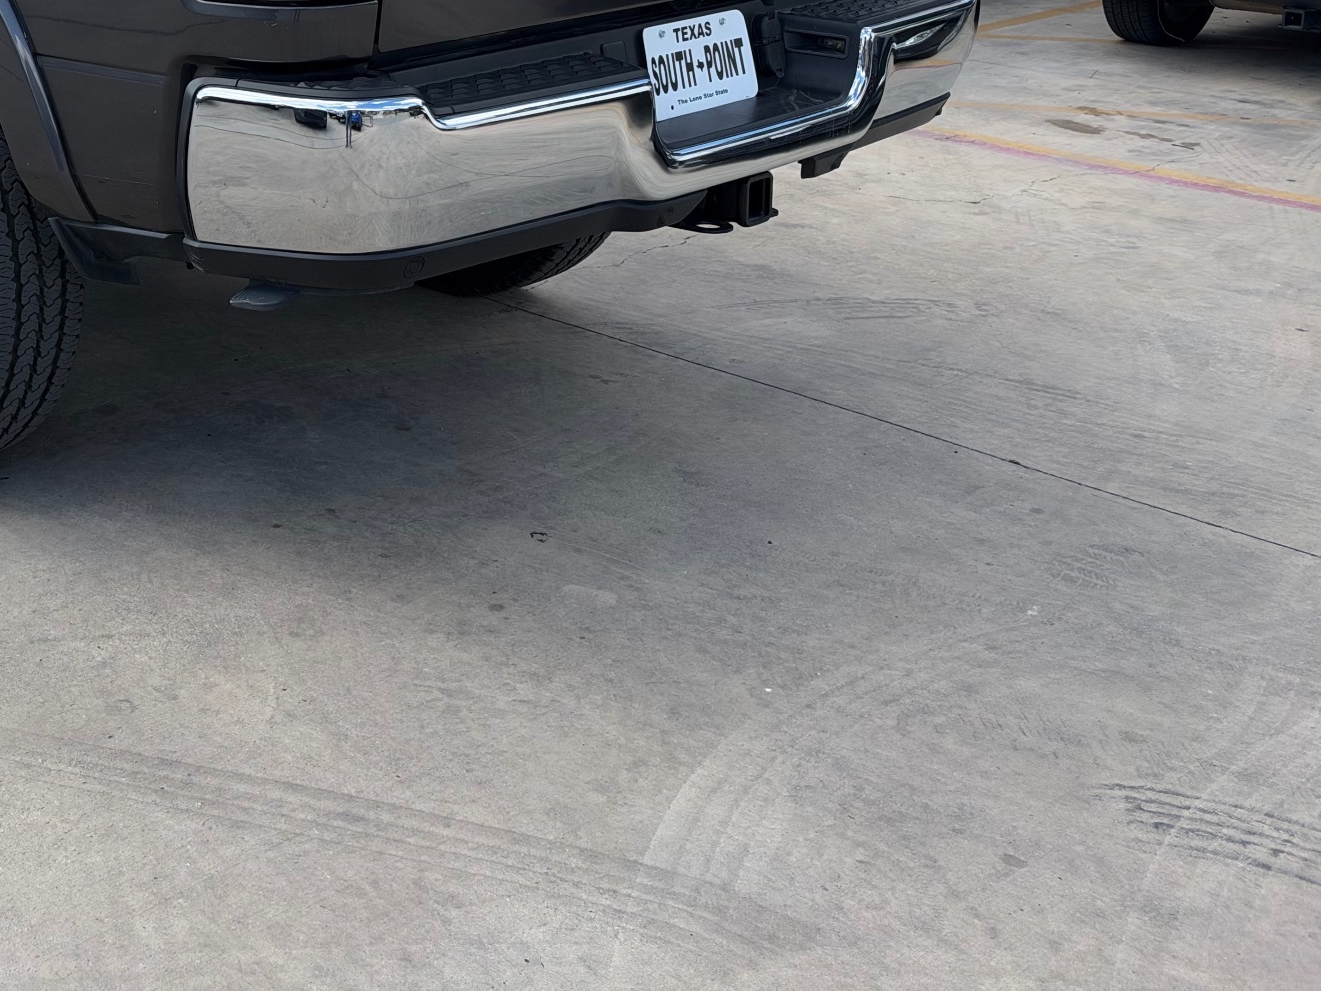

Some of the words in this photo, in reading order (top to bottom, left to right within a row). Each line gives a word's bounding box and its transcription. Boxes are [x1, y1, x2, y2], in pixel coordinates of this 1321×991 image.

[672, 21, 712, 43] TEXAS
[688, 95, 703, 103] Lone
[714, 88, 729, 96] State
